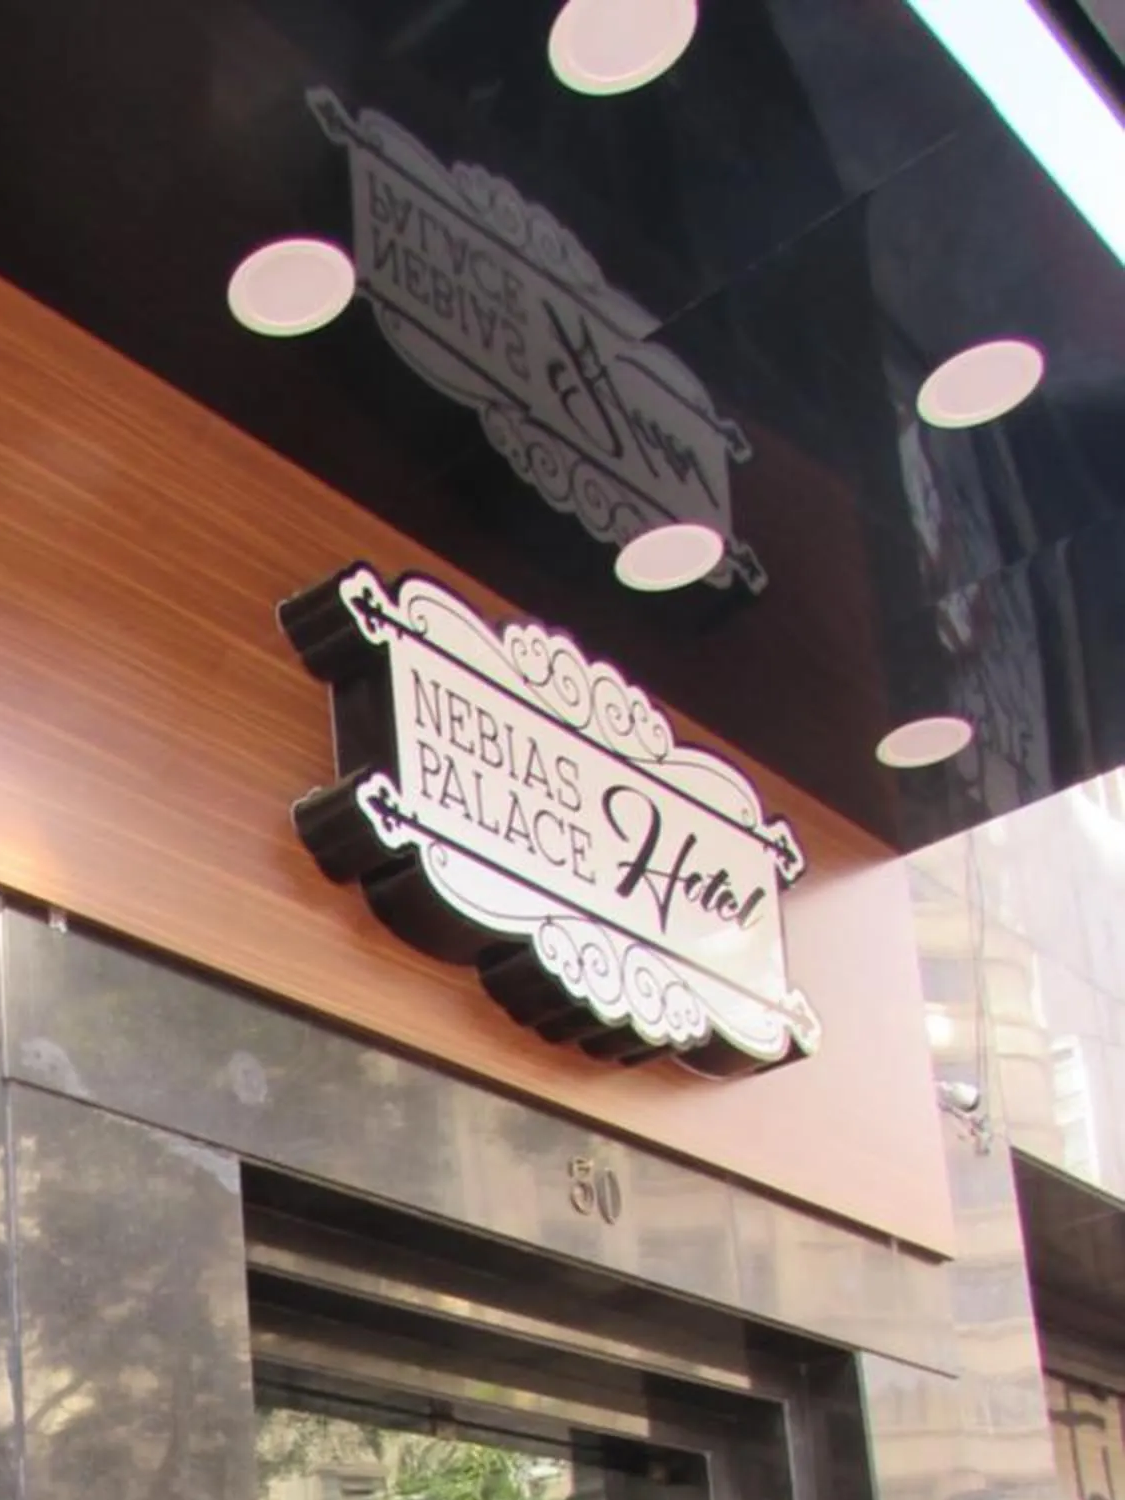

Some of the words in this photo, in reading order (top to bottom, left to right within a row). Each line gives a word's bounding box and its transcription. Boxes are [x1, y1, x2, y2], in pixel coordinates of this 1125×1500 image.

[411, 668, 583, 813] NEBIAS
[415, 738, 597, 886] PALACE
[601, 784, 767, 935] Hotel
[566, 1157, 623, 1226] 50
